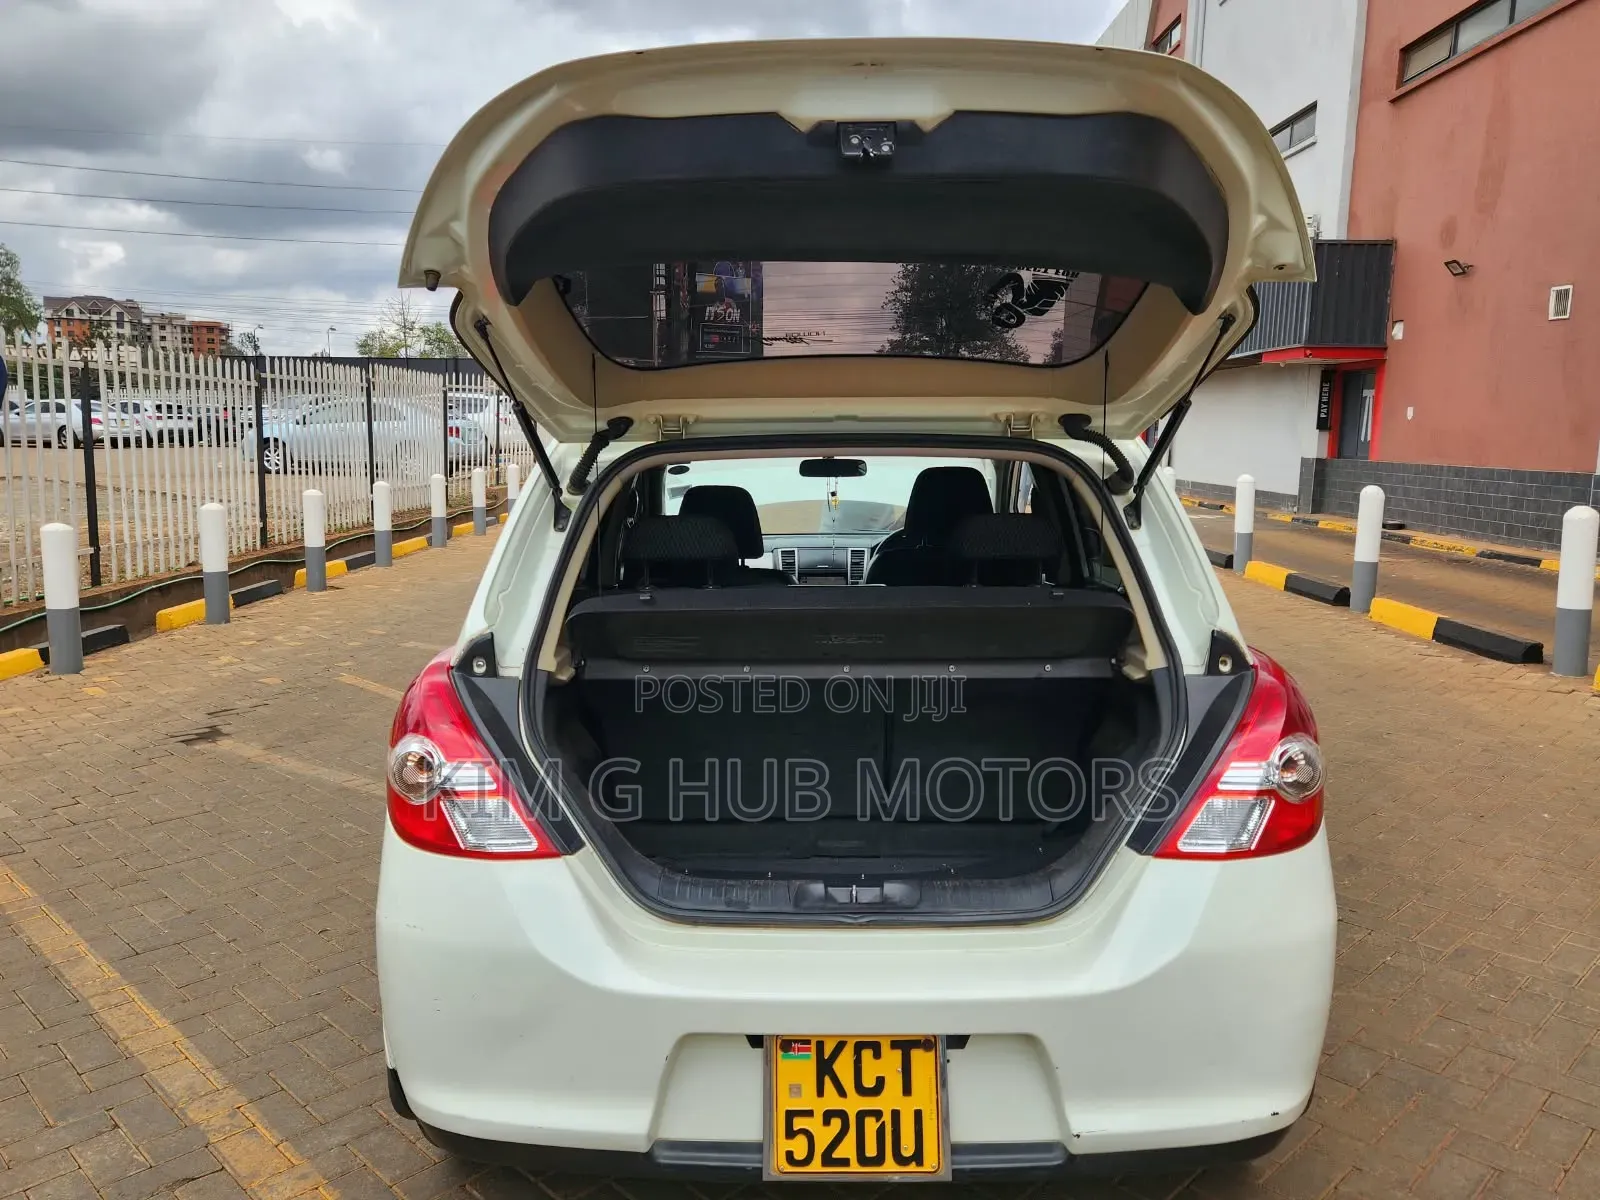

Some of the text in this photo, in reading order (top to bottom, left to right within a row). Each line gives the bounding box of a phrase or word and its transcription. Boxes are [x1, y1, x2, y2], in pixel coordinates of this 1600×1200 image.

[1320, 383, 1329, 417] PAY HERE
[815, 1039, 926, 1098] KCT
[784, 1109, 924, 1168] 520U
